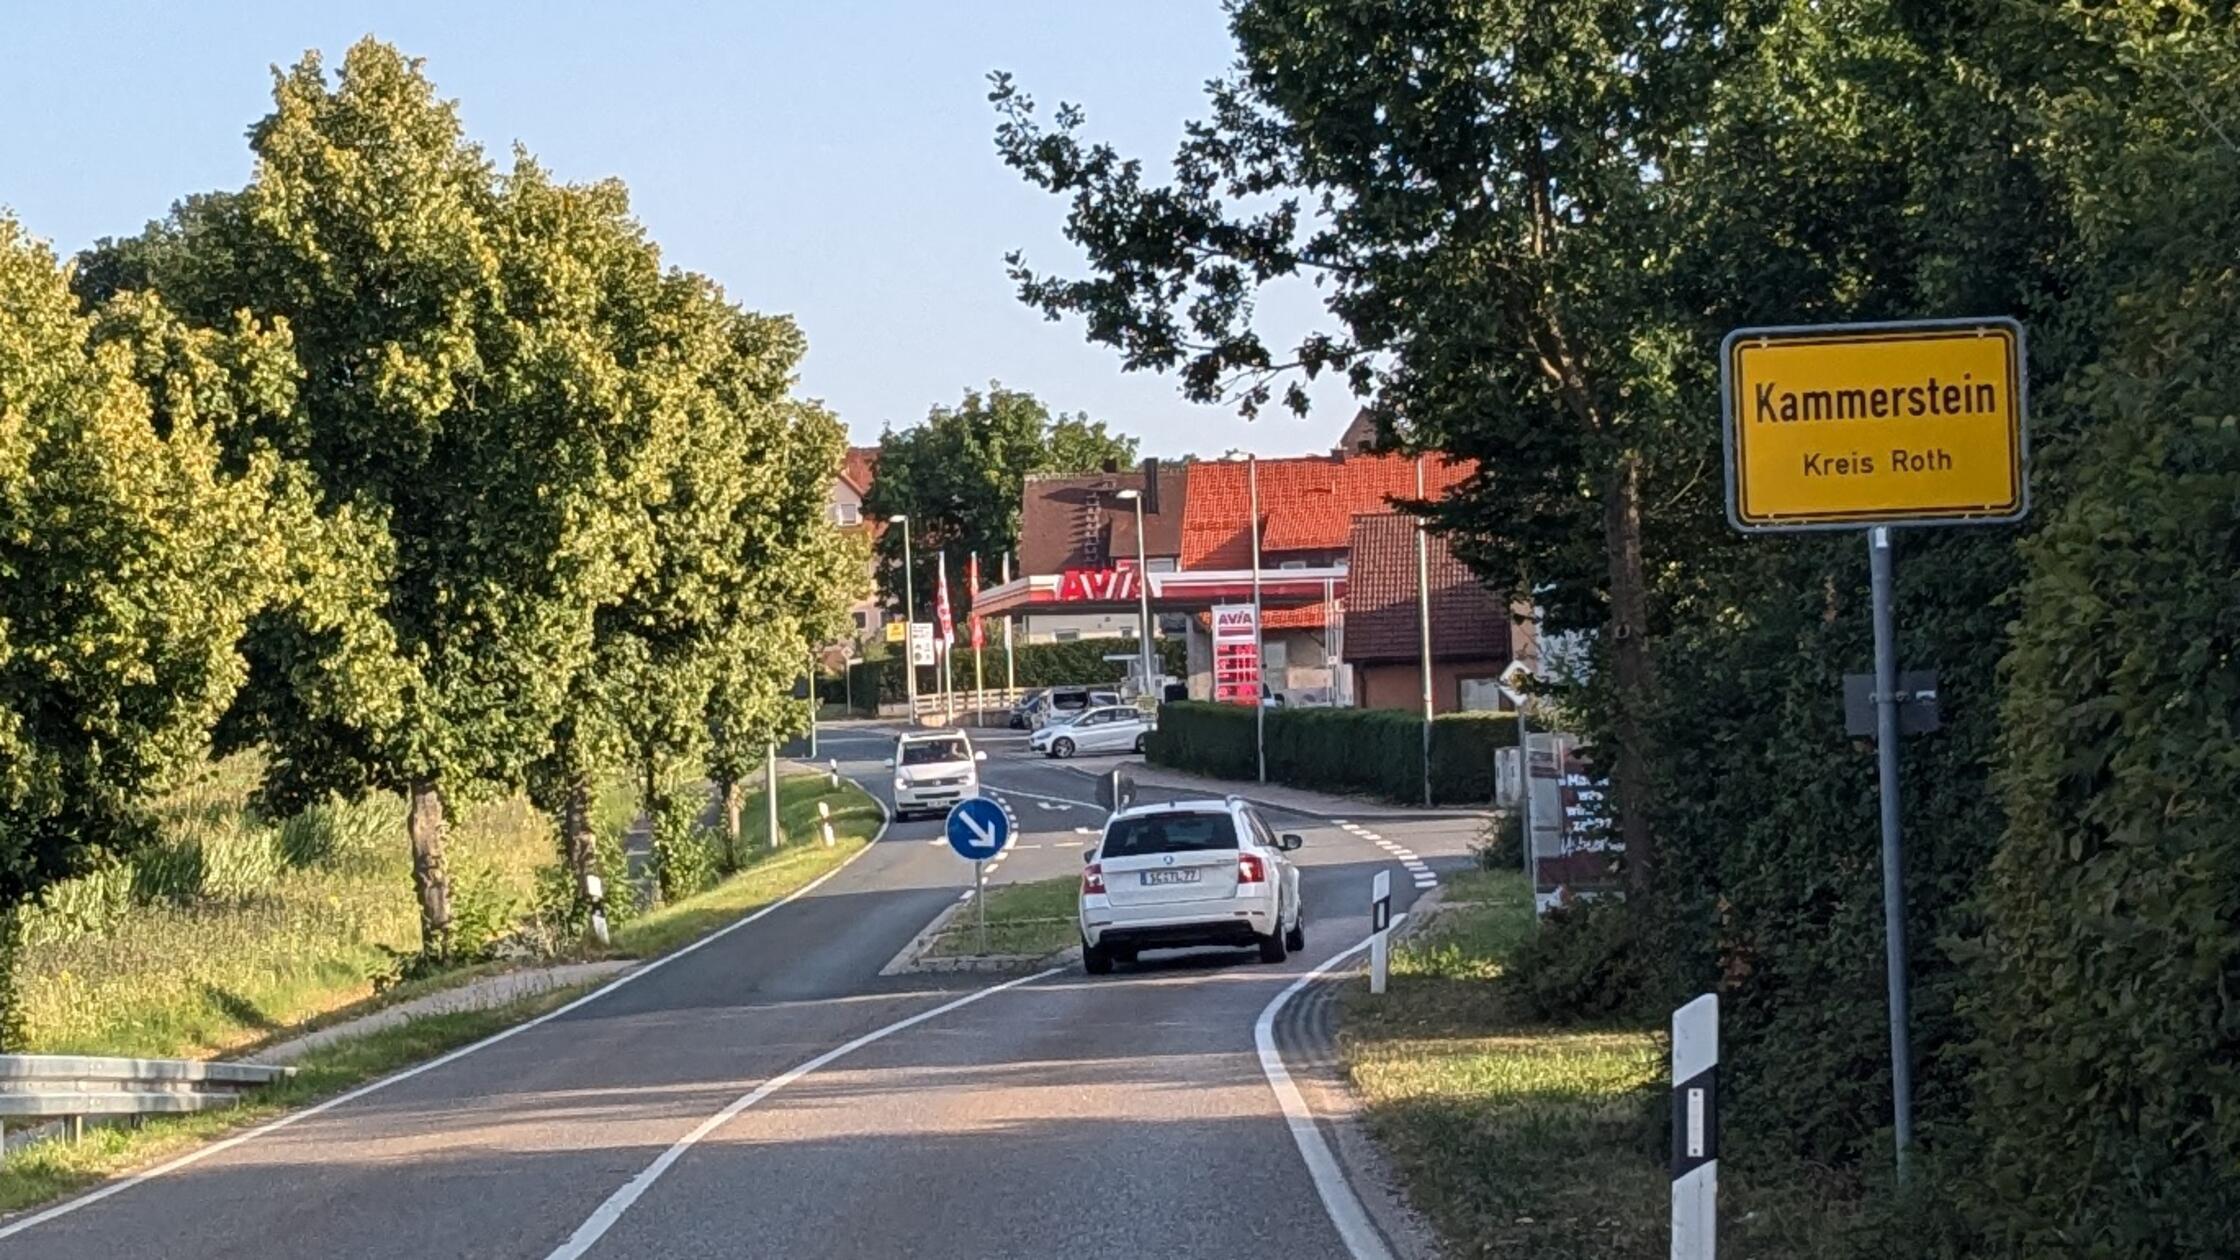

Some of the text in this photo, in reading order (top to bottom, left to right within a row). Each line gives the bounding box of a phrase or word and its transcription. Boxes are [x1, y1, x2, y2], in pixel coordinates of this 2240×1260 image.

[1755, 372, 1996, 424] Kammerstein
[1803, 448, 1952, 476] Kreis Roth
